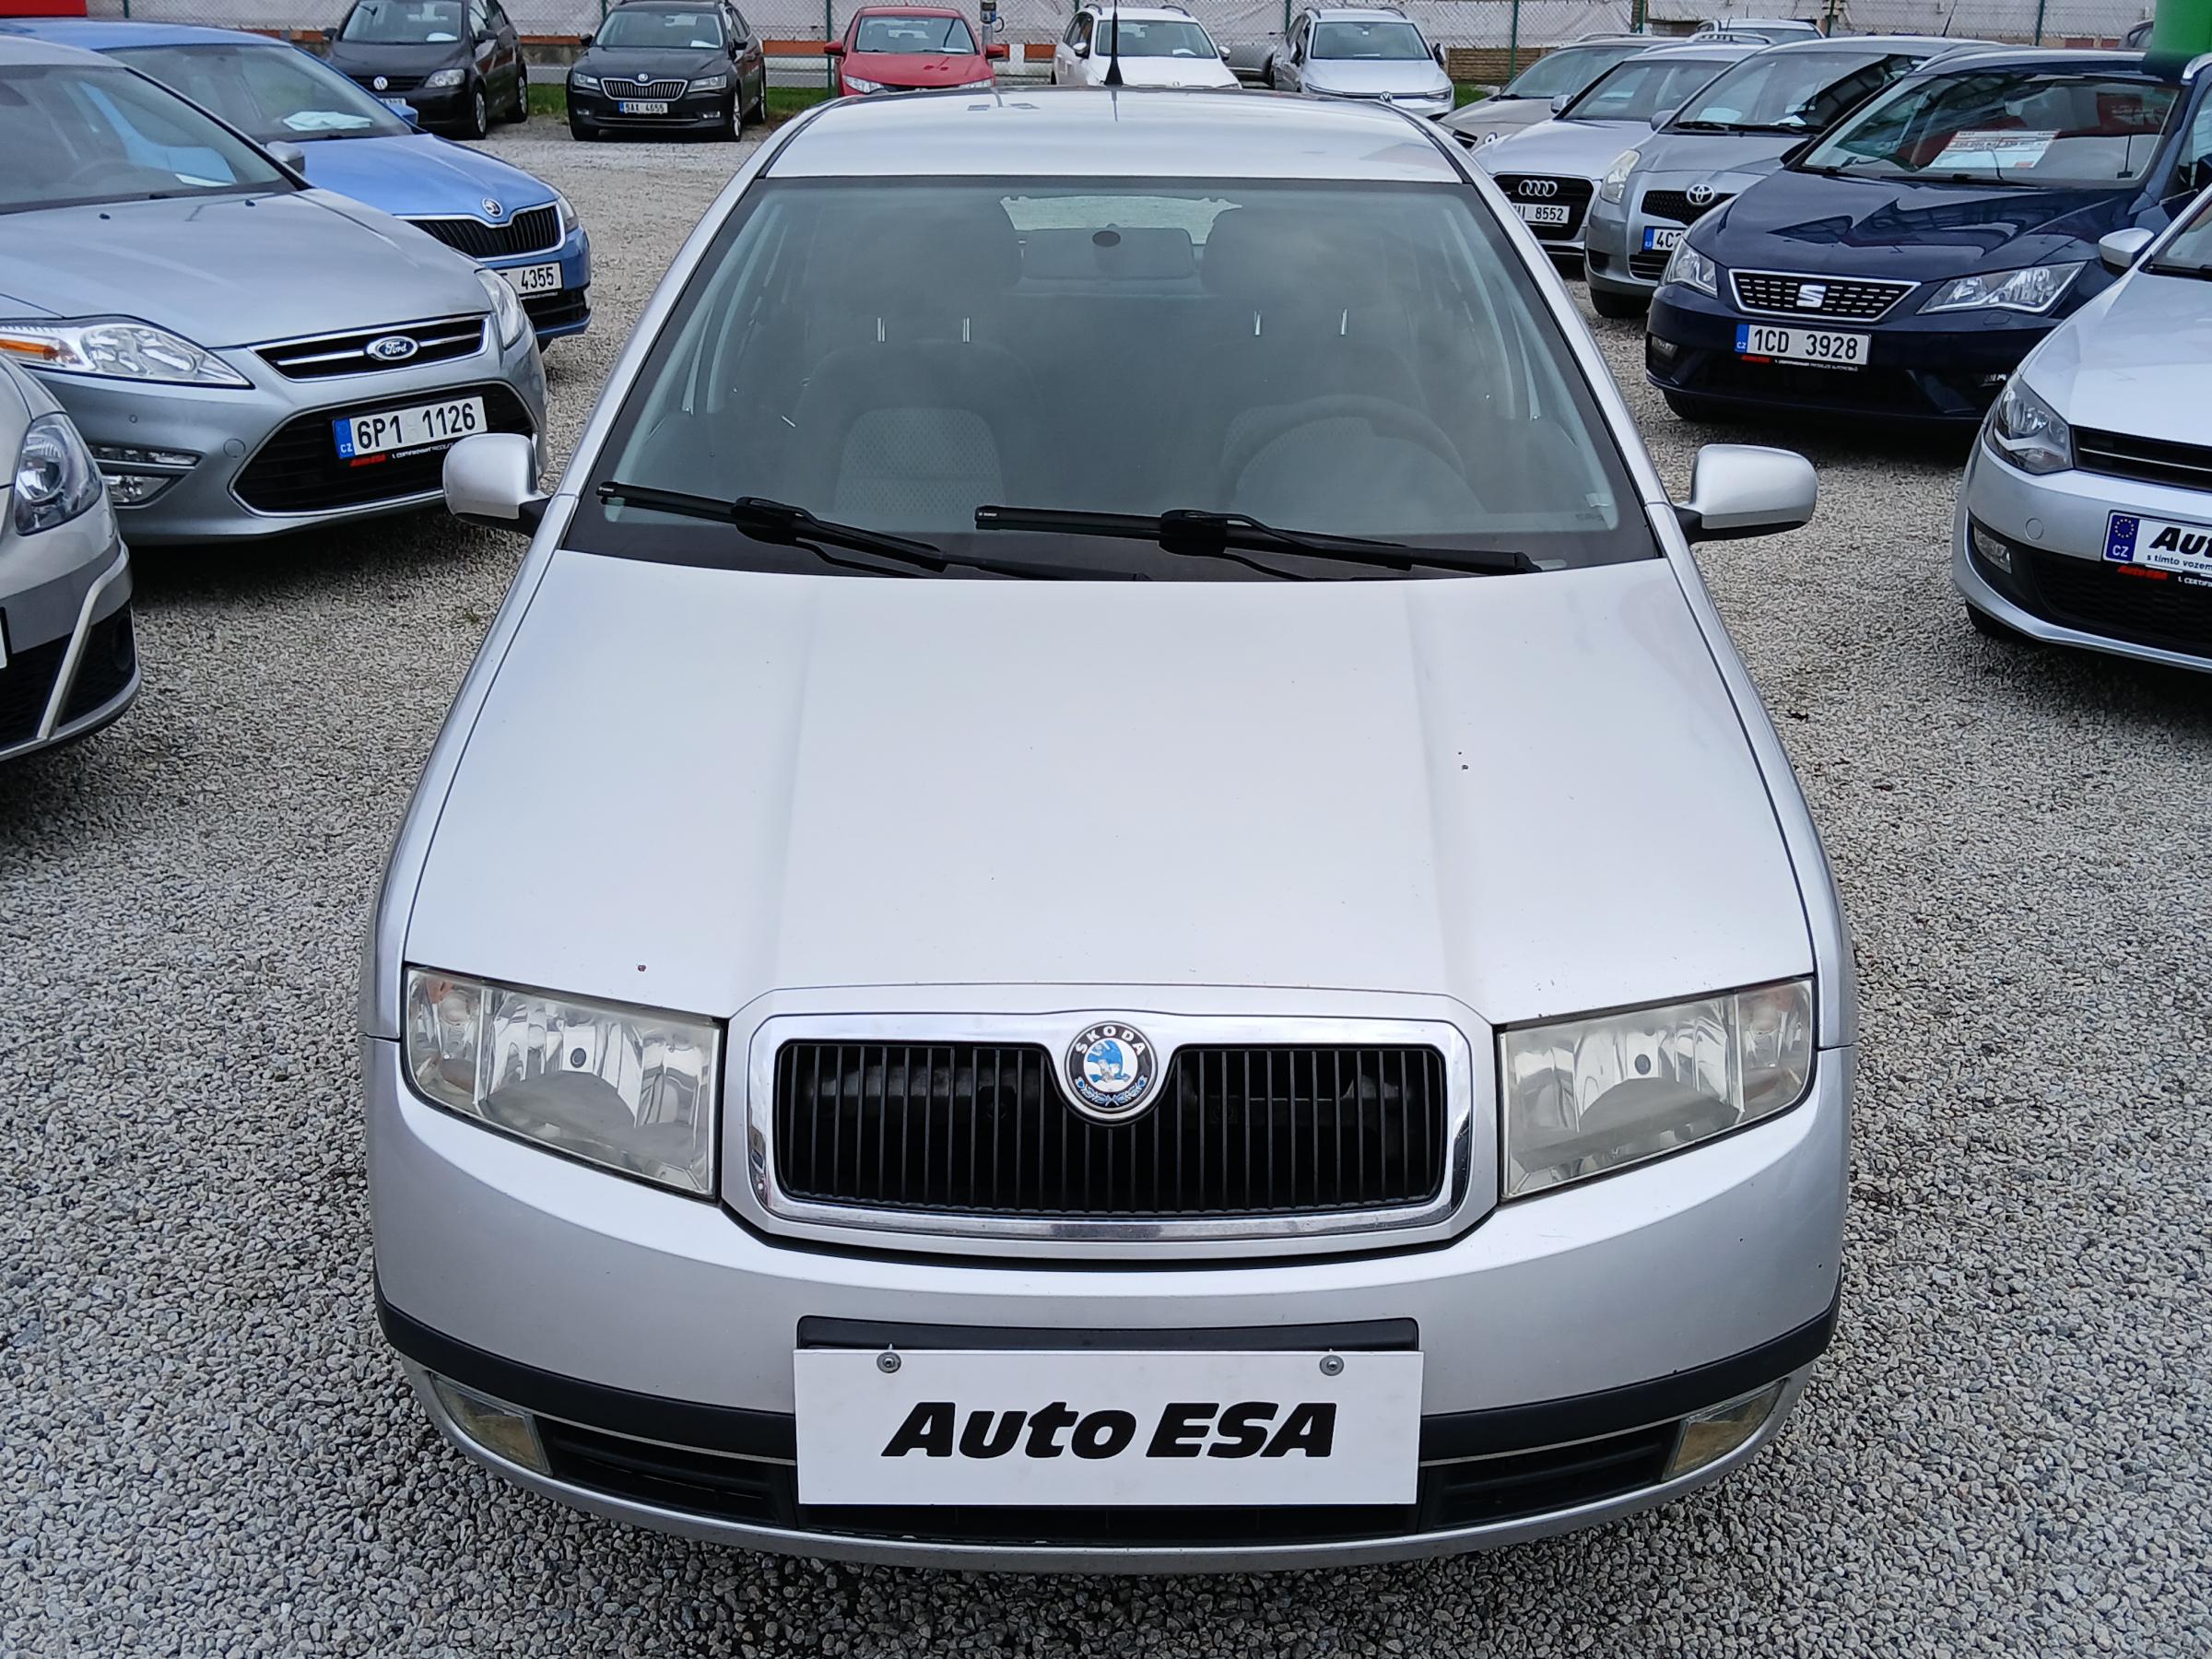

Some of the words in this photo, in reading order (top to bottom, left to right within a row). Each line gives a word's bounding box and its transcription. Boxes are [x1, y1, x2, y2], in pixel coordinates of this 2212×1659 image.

[1535, 207, 1564, 221] 8552
[521, 266, 554, 290] 4355
[384, 340, 407, 355] Ford
[1754, 328, 1790, 354] 1CD
[1805, 334, 1858, 359] 3928
[357, 415, 403, 450] 6P1
[422, 403, 477, 438] 1126
[340, 442, 353, 453] CZ
[2112, 545, 2129, 558] CZ
[880, 1401, 1136, 1459] Auto
[1146, 1401, 1337, 1459] ESA
